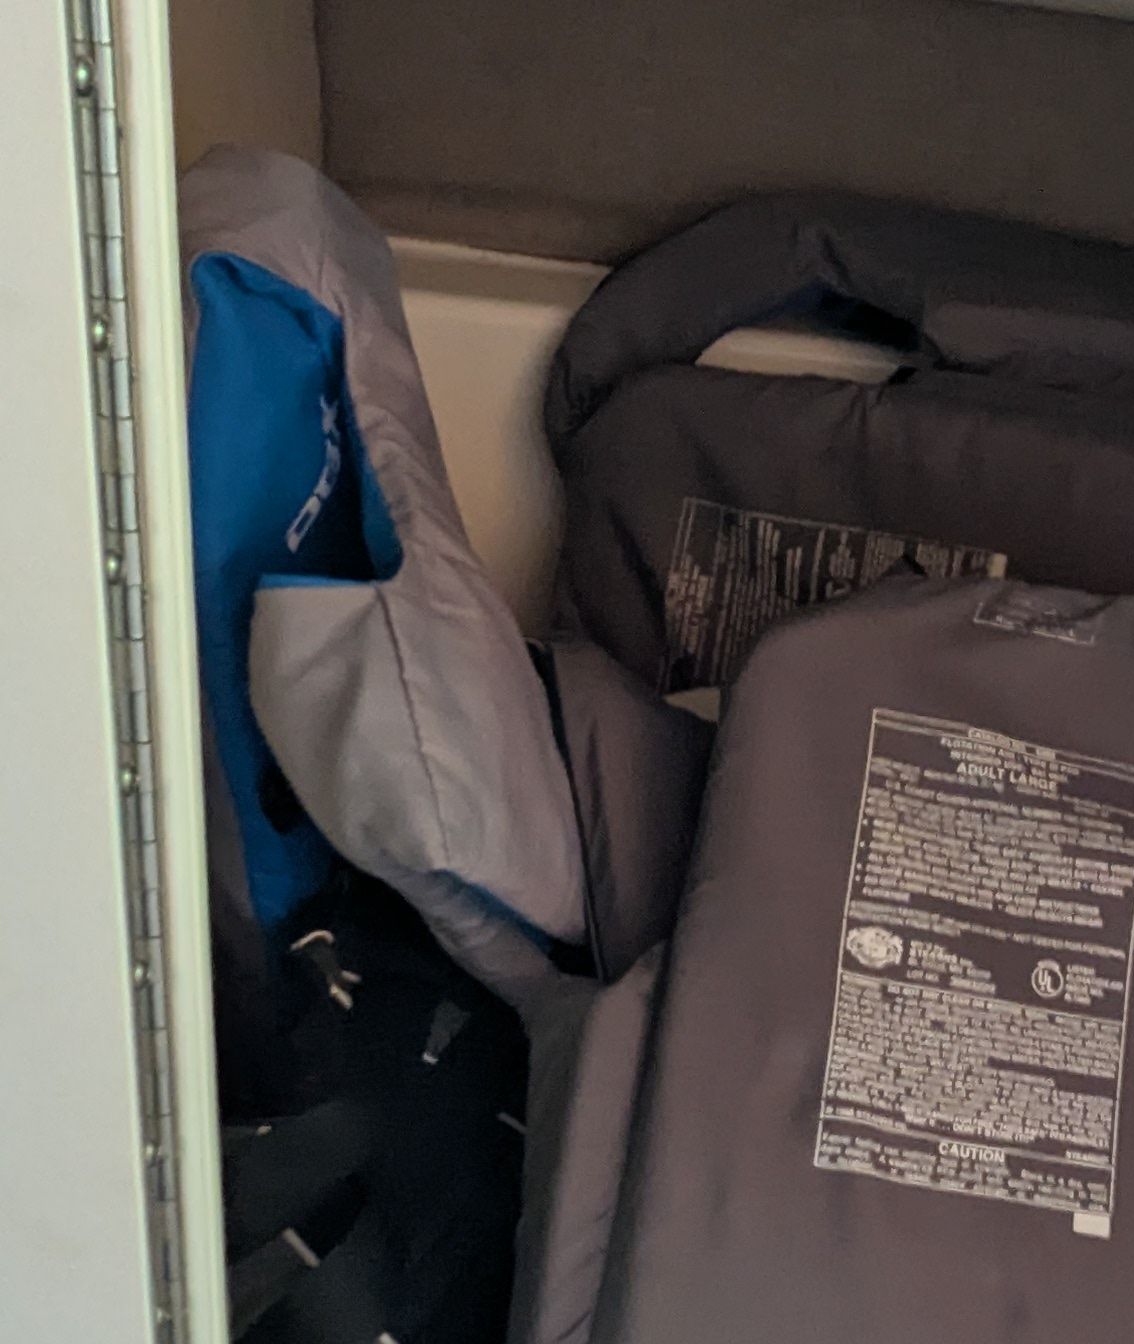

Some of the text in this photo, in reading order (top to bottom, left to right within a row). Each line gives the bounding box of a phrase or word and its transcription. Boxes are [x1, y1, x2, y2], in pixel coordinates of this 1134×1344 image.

[957, 762, 1058, 793] ADULT LARGE
[938, 1142, 1005, 1163] CAUTION
